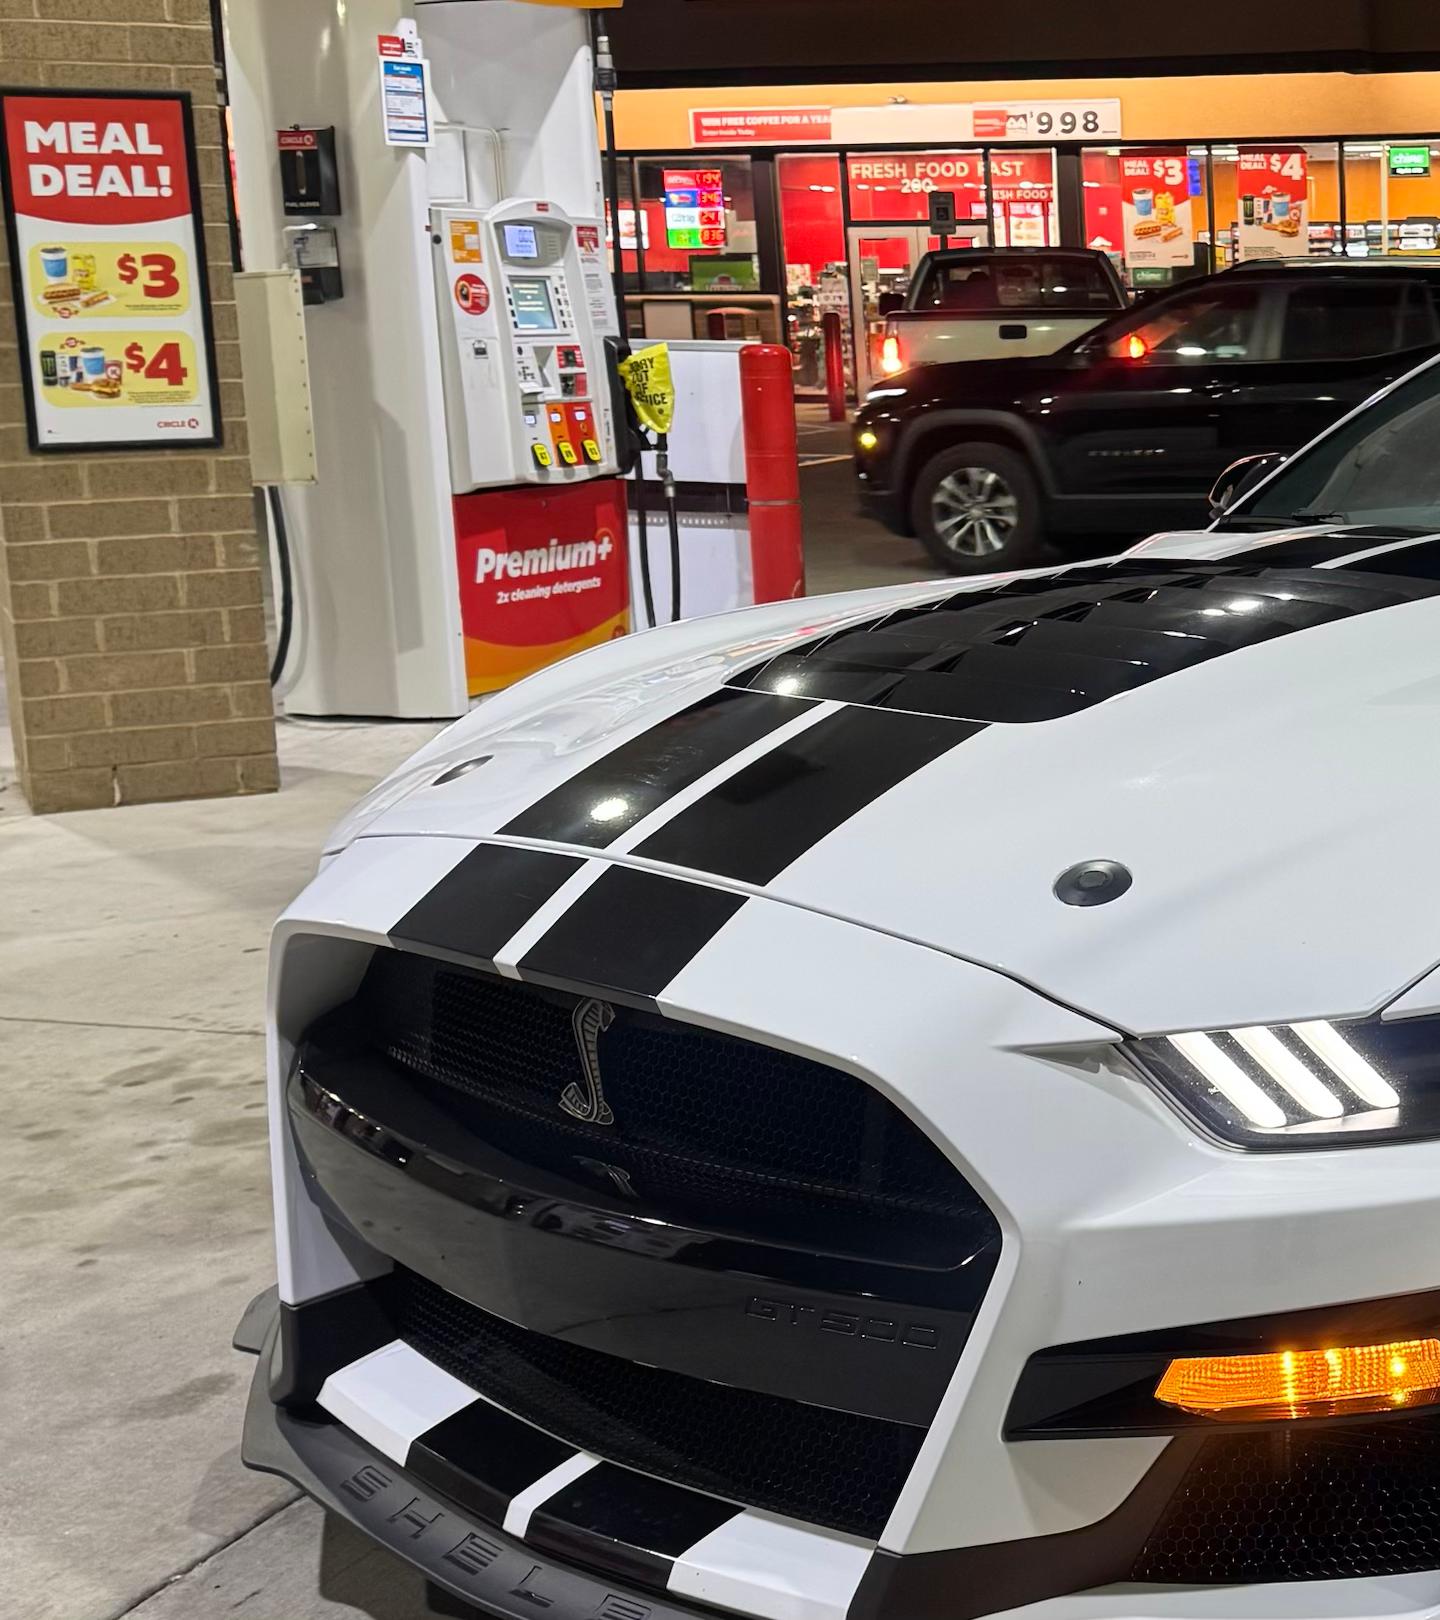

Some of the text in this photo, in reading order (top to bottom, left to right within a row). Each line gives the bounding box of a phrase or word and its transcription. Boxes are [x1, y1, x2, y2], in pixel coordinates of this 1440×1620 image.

[721, 116, 745, 127] FREE
[746, 115, 779, 126] COFFEE
[24, 121, 163, 155] MEAL
[28, 164, 173, 198] DEAL!
[851, 161, 1024, 179] FRESH FOOD FAST
[1153, 159, 1184, 185] $3
[1270, 153, 1304, 180] $4
[1016, 189, 1048, 199] FOOD
[116, 253, 180, 299] $3
[124, 342, 188, 386] $4
[475, 536, 613, 584] Premium+
[496, 577, 602, 604] 2x cleaning detergents
[338, 1464, 654, 1620] SHELB
